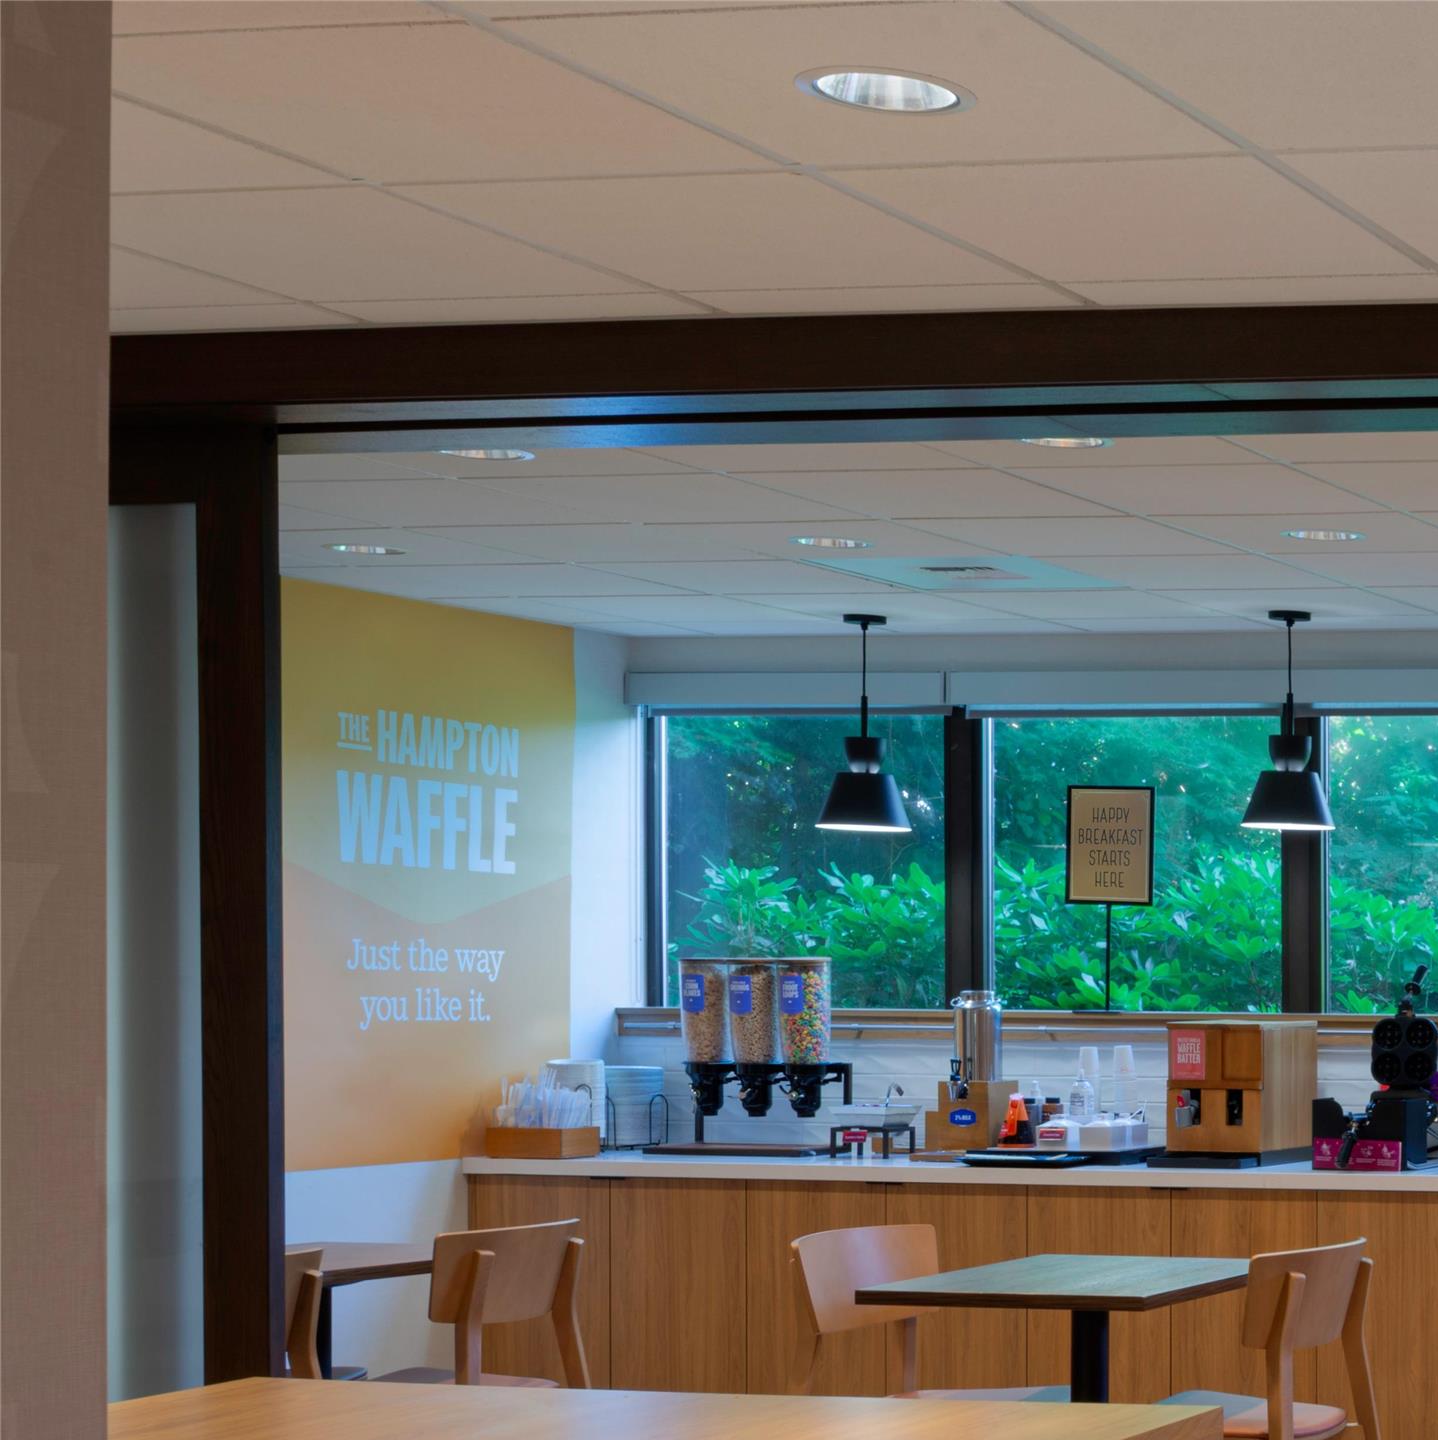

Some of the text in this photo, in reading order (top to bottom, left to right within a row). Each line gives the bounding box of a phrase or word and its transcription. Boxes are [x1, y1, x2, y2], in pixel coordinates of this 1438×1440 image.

[338, 709, 520, 778] THE HAMPTON
[336, 770, 518, 875] WAFFLE
[1092, 807, 1131, 824] HAPPY
[1077, 827, 1144, 846] BREAKFAST
[1088, 849, 1131, 867] STARTS
[1094, 871, 1125, 889] HERE
[347, 938, 505, 982] Just the way
[359, 987, 491, 1031] you like it.
